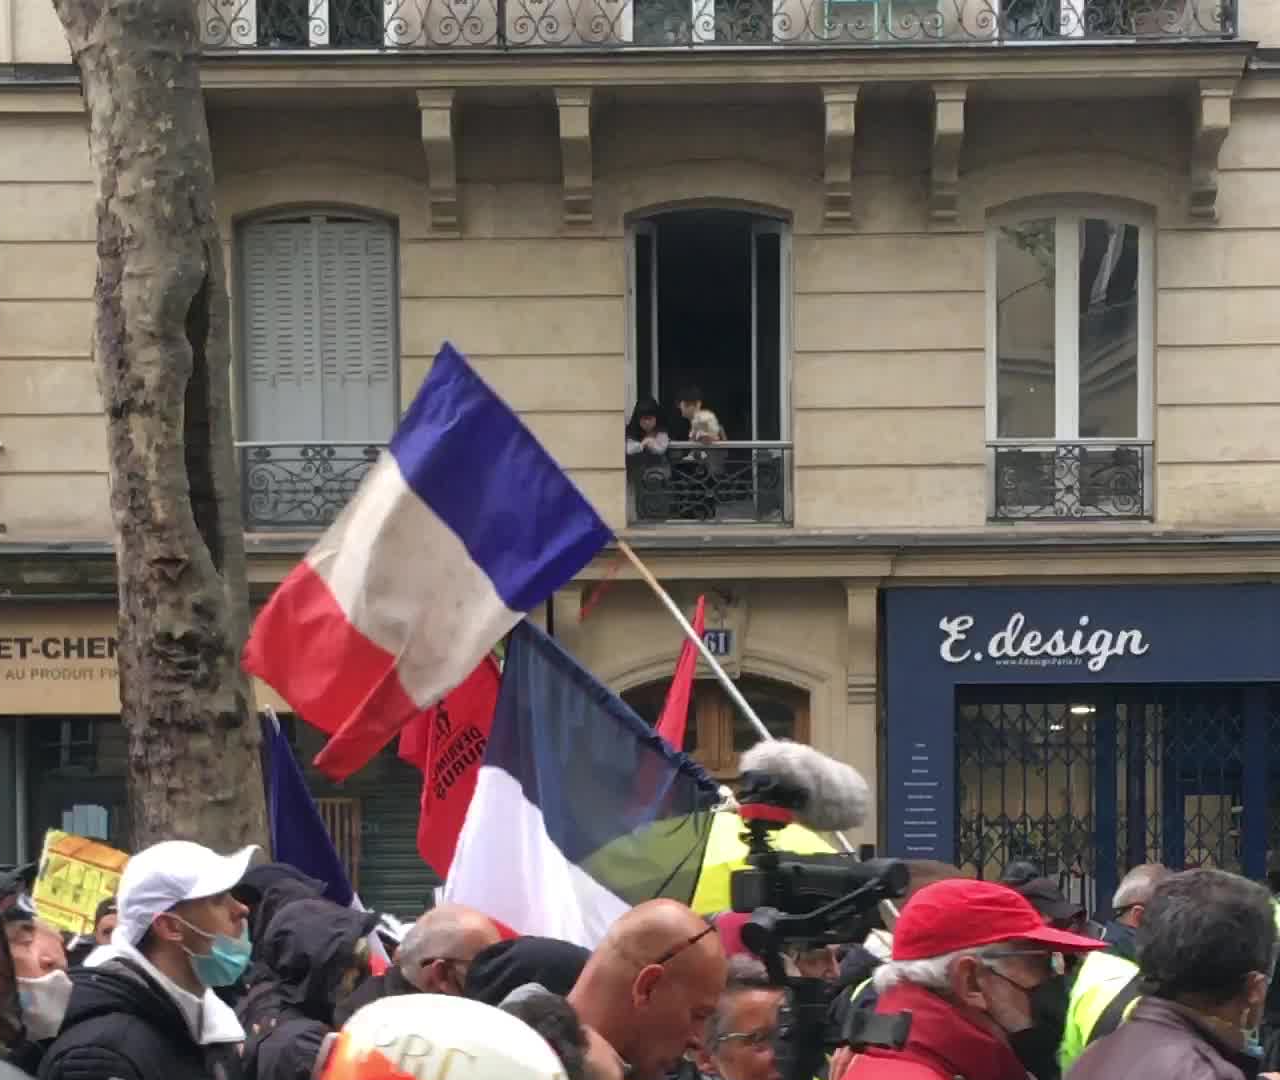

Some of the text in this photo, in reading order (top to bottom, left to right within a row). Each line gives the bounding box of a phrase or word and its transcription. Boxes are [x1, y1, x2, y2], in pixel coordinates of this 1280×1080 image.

[704, 632, 726, 653] 61
[939, 612, 1150, 672] E.design
[5, 668, 25, 680] AU
[31, 668, 93, 680] PRODUIT
